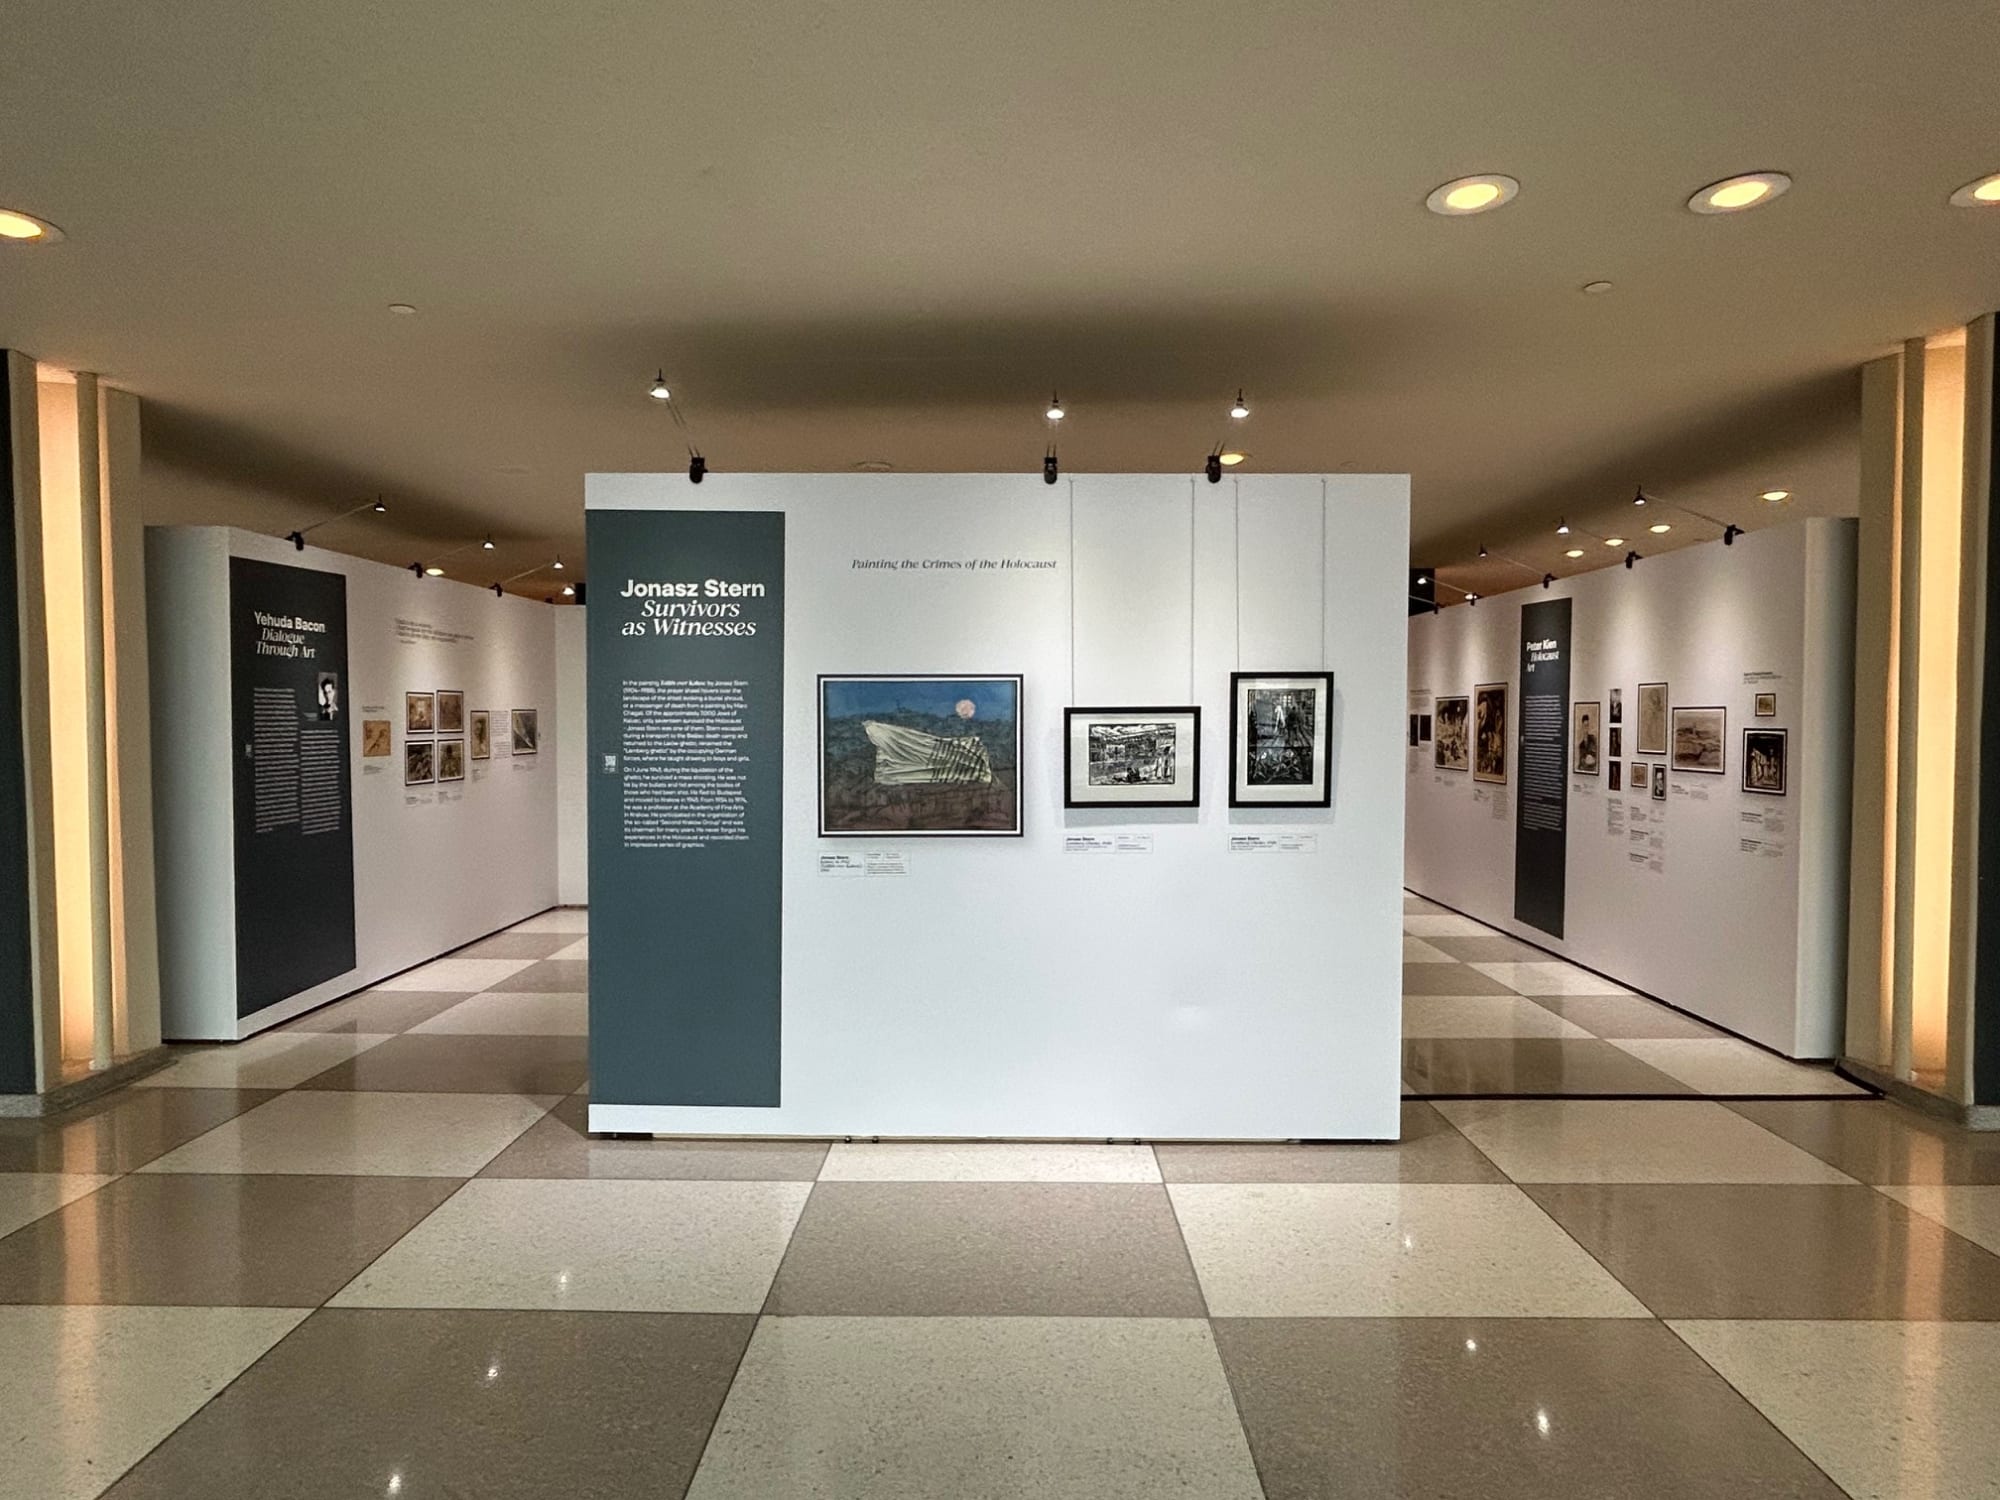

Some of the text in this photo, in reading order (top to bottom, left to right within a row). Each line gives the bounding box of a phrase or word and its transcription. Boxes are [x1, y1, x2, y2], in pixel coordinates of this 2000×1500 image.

[851, 559, 1057, 571] Painting the Crimes of the Holocaust
[620, 579, 765, 597] Jonasz Stern
[641, 599, 741, 618] Survivors
[254, 611, 326, 633] Yehuda Bacon
[622, 618, 757, 636] as Witnesses
[262, 627, 305, 645] Dialogue
[256, 641, 316, 658] Through Art
